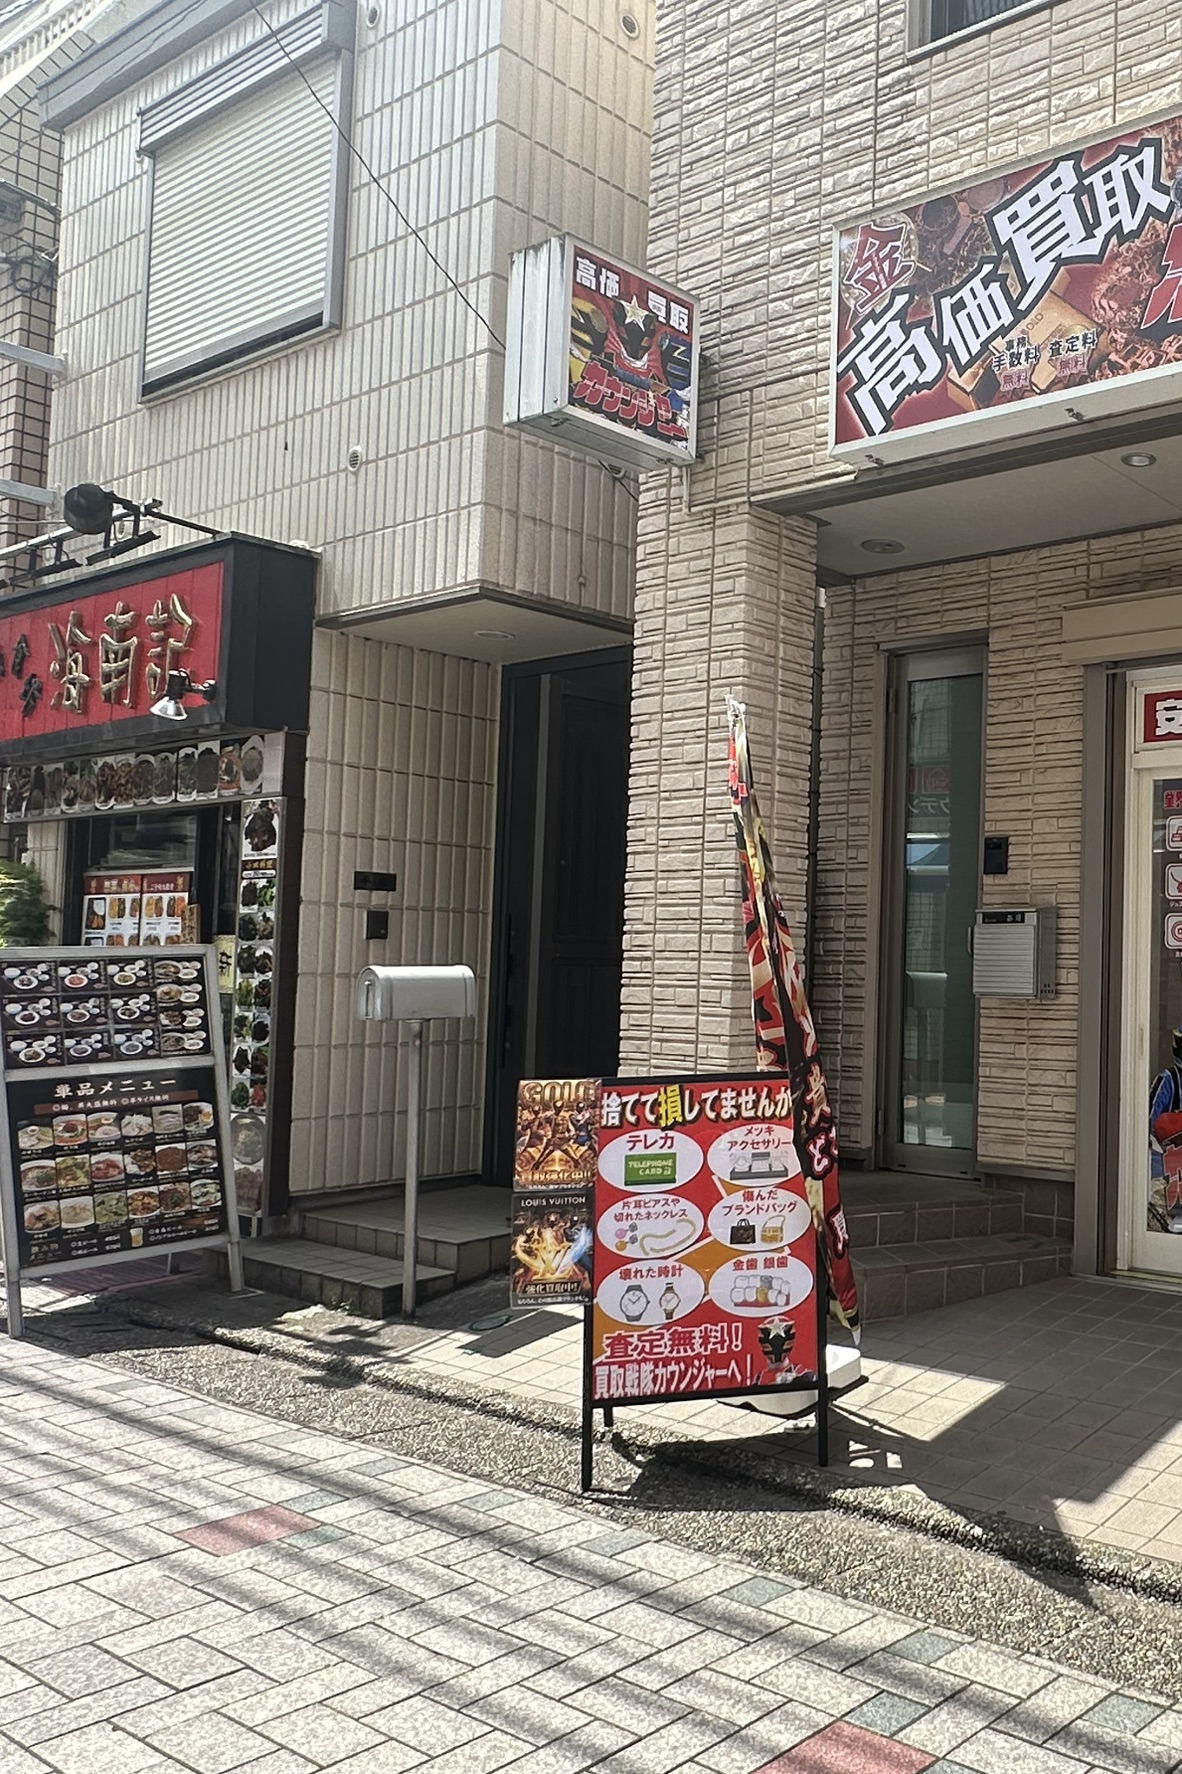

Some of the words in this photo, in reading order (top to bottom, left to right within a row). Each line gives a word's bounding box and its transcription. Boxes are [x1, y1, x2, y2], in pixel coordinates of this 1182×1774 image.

[846, 221, 916, 314] 金
[575, 256, 620, 300] 高価
[647, 290, 690, 334] 買取
[838, 147, 1171, 436] 高価買取
[1048, 330, 1097, 359] 査定料
[992, 344, 1040, 372] 手数料
[573, 361, 688, 437] カウンジャー
[53, 1078, 177, 1099] 単品メニュー
[744, 1126, 775, 1137] メッキ
[627, 1134, 675, 1151] テレカ
[728, 1139, 793, 1151] アクセサリー
[628, 1159, 674, 1169] TELEPHONE
[521, 1198, 547, 1207] LOUIS
[549, 1196, 586, 1204] VUITTON
[742, 1188, 779, 1203] 傷んだ
[621, 1198, 681, 1211] 片耳ピアスや
[722, 1200, 798, 1216] ブランドバッグ
[613, 1209, 689, 1222] 切れたネックレス
[619, 1264, 684, 1281] 壊れた時計
[732, 1258, 760, 1272] 金歯
[603, 1322, 744, 1363] 査定無料!
